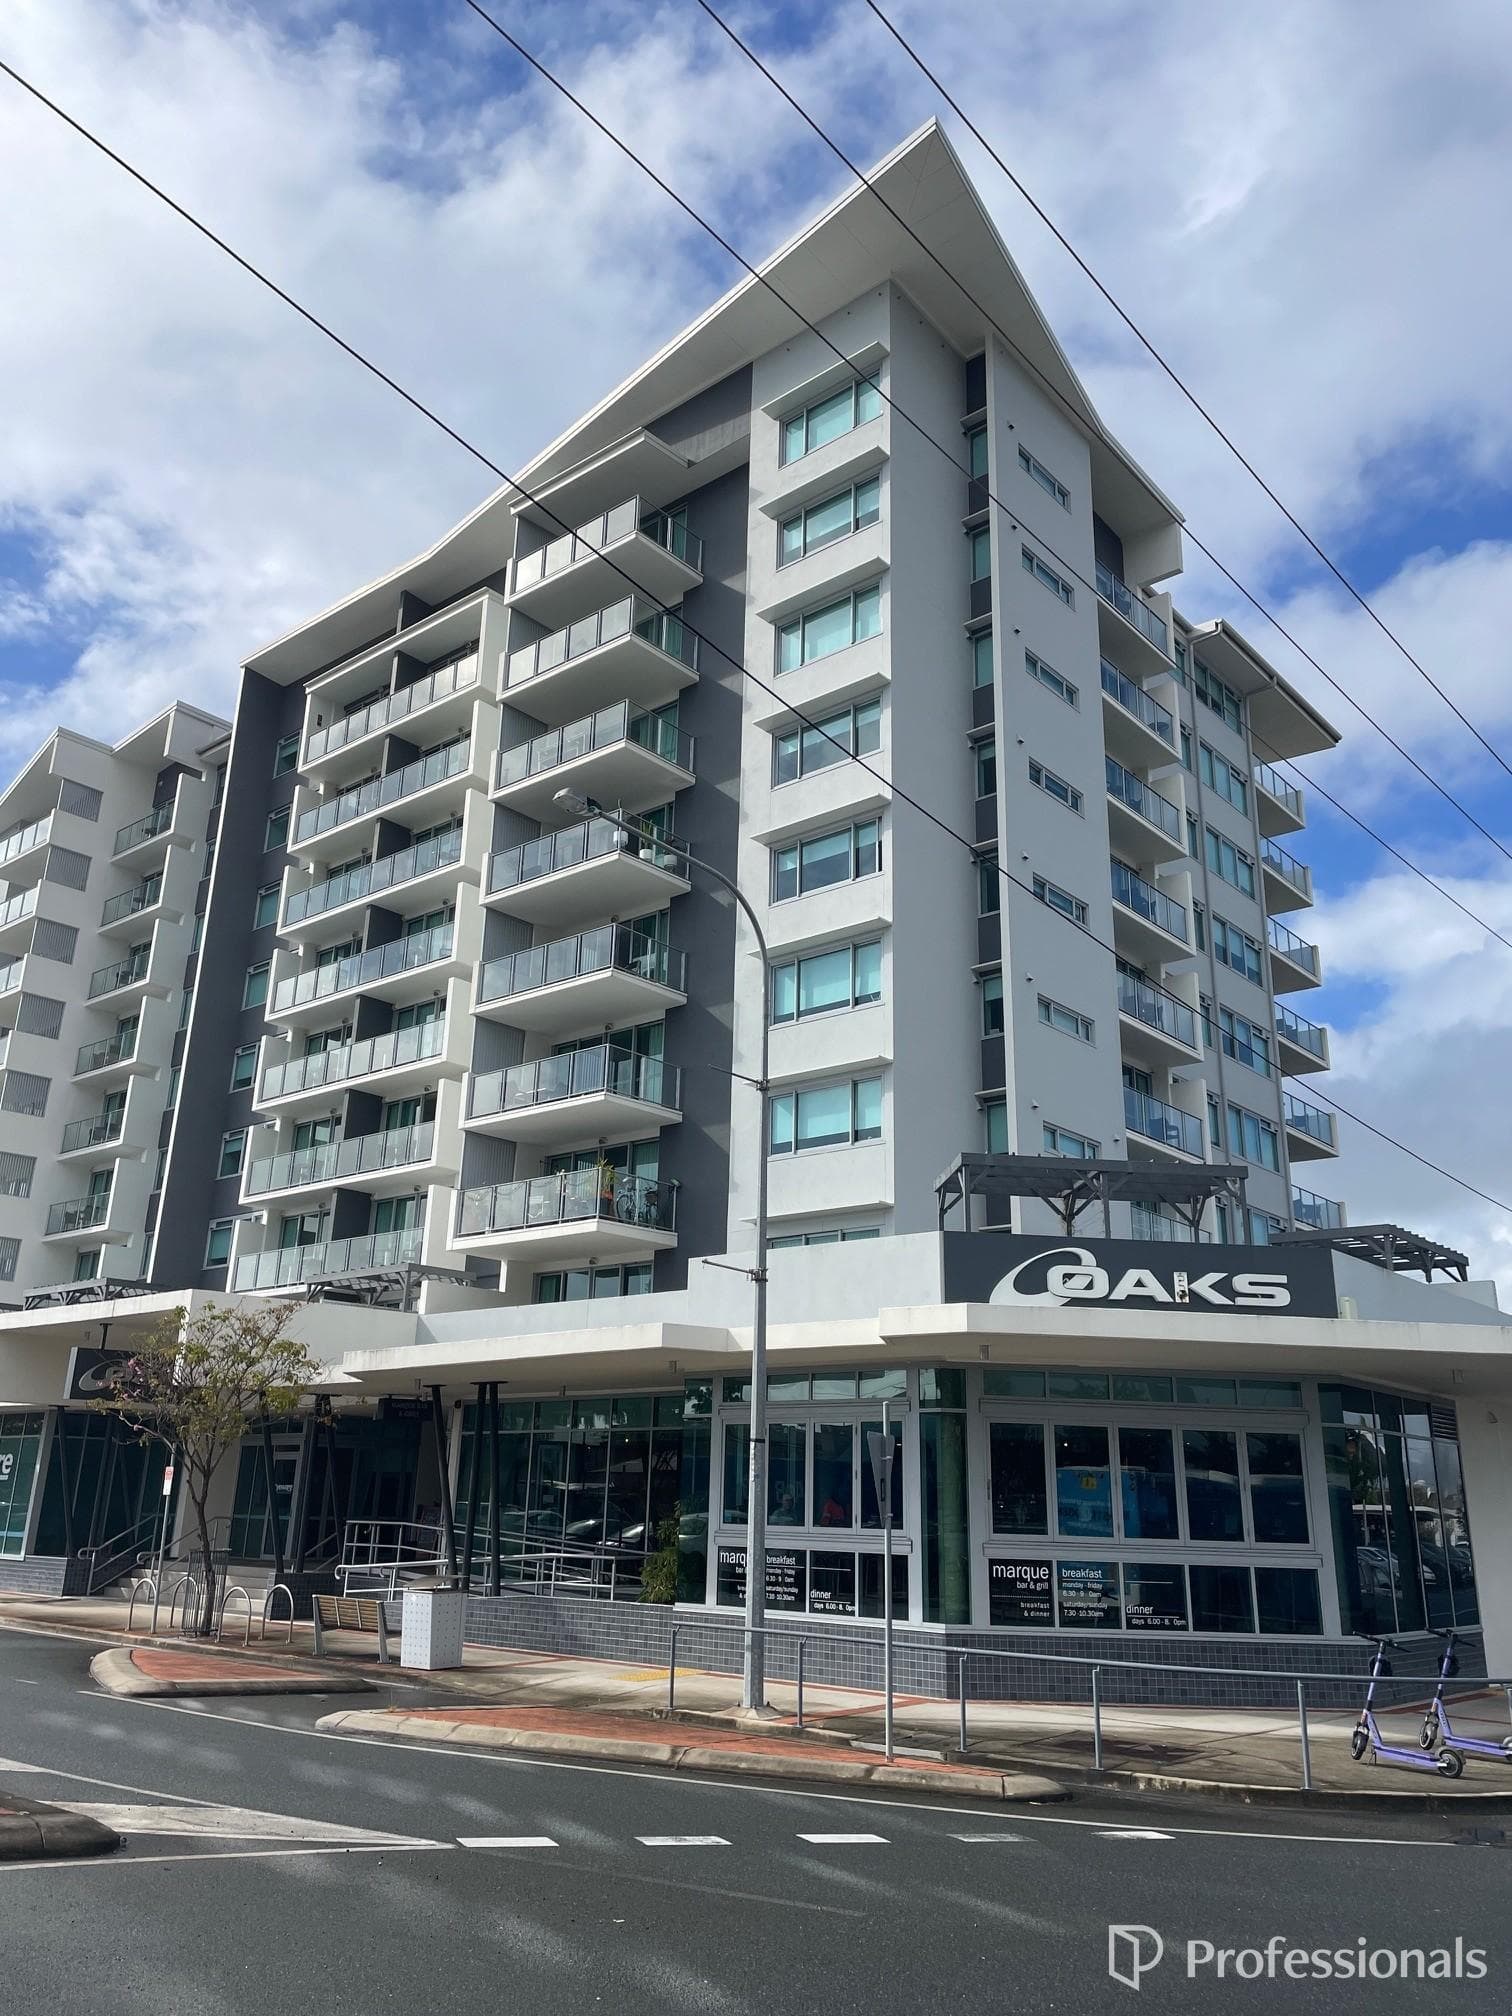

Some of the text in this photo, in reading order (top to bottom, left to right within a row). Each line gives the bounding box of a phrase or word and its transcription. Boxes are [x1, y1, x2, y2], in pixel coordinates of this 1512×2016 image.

[1047, 1264, 1291, 1307] OAKS
[720, 1552, 747, 1567] marq
[767, 1555, 796, 1565] breakfast
[992, 1565, 1049, 1582] marque
[1062, 1568, 1103, 1578] breakfast
[1016, 1580, 1049, 1591] bar & grill
[1087, 1582, 1103, 1590] friday
[810, 1588, 831, 1599] dinner
[1126, 1604, 1154, 1614] dinner
[1132, 1618, 1144, 1626] days
